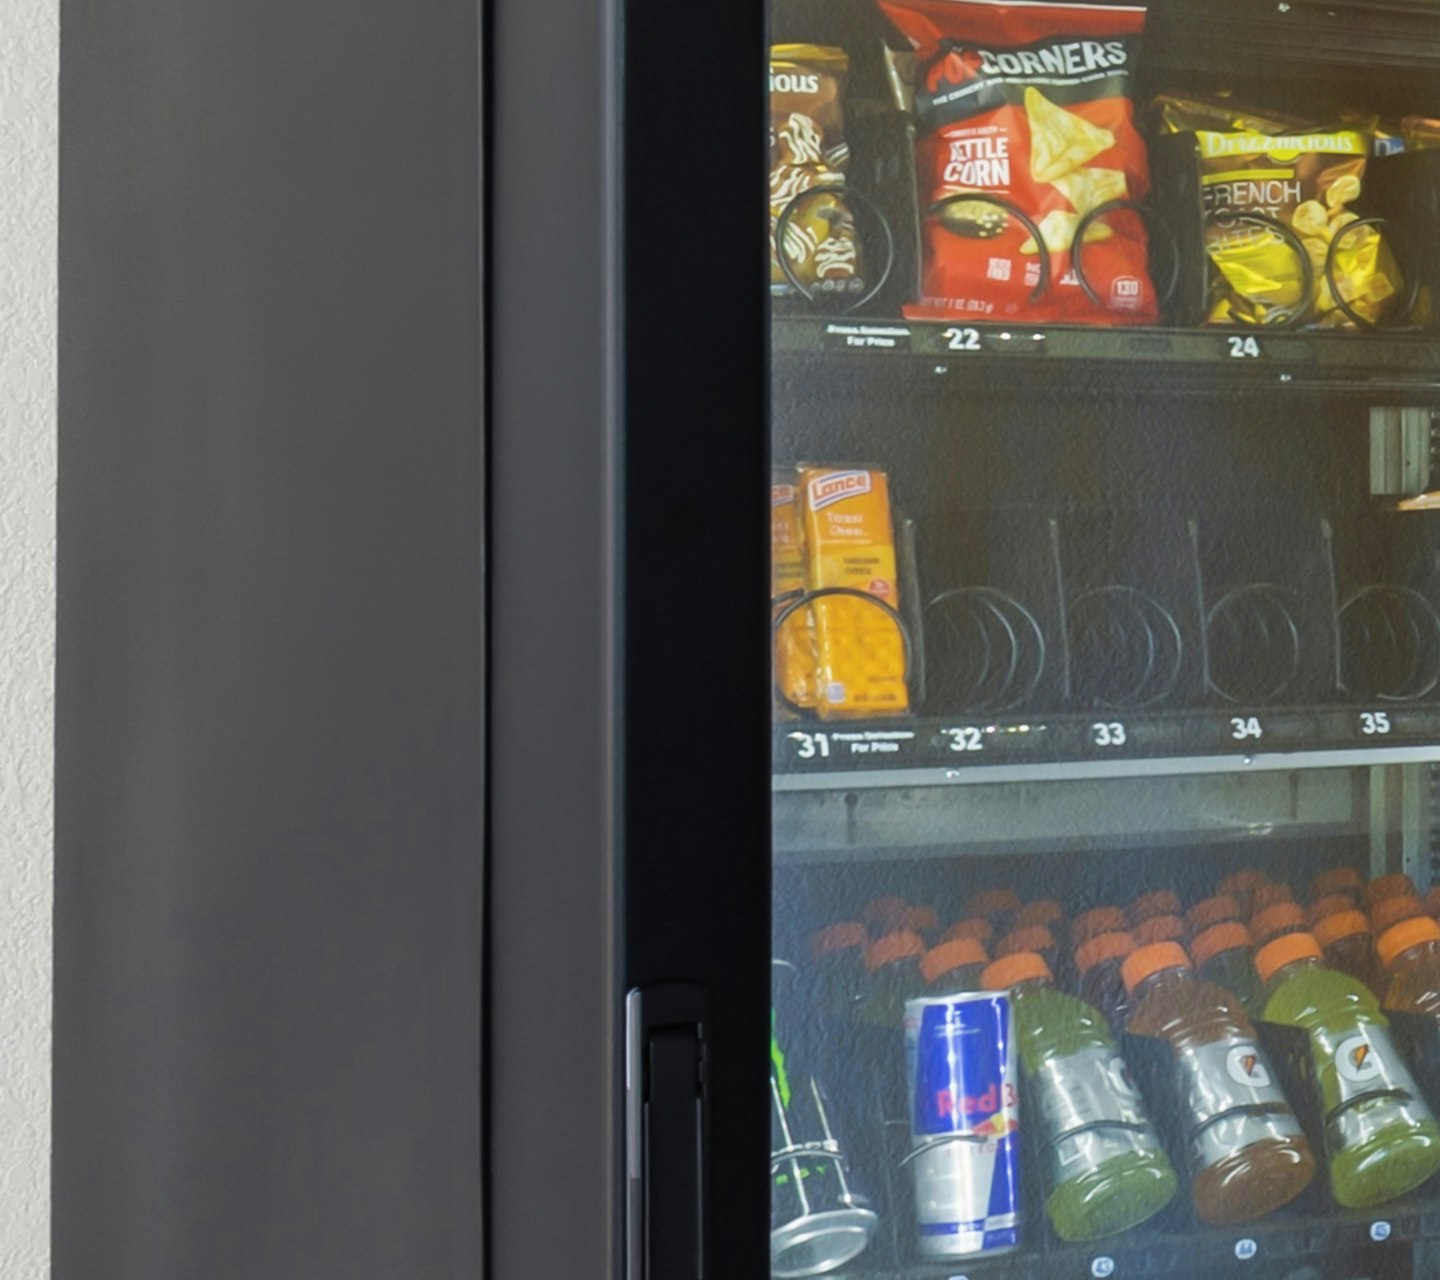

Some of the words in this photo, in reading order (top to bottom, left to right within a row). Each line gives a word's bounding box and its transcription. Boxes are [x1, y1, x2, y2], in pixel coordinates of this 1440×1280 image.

[978, 41, 1128, 75] CORNERS
[944, 159, 1010, 187] CORN
[1203, 181, 1301, 206] FRENCH
[847, 335, 865, 345] For
[867, 336, 895, 347] Price
[948, 328, 981, 350] 22
[1228, 337, 1260, 358] 24
[813, 476, 867, 500] Lance
[1093, 722, 1126, 745] 33
[1230, 717, 1262, 739] 34
[1360, 712, 1391, 734] 35
[797, 731, 830, 758] 31
[949, 727, 983, 751] 32
[937, 1084, 997, 1118] Red
